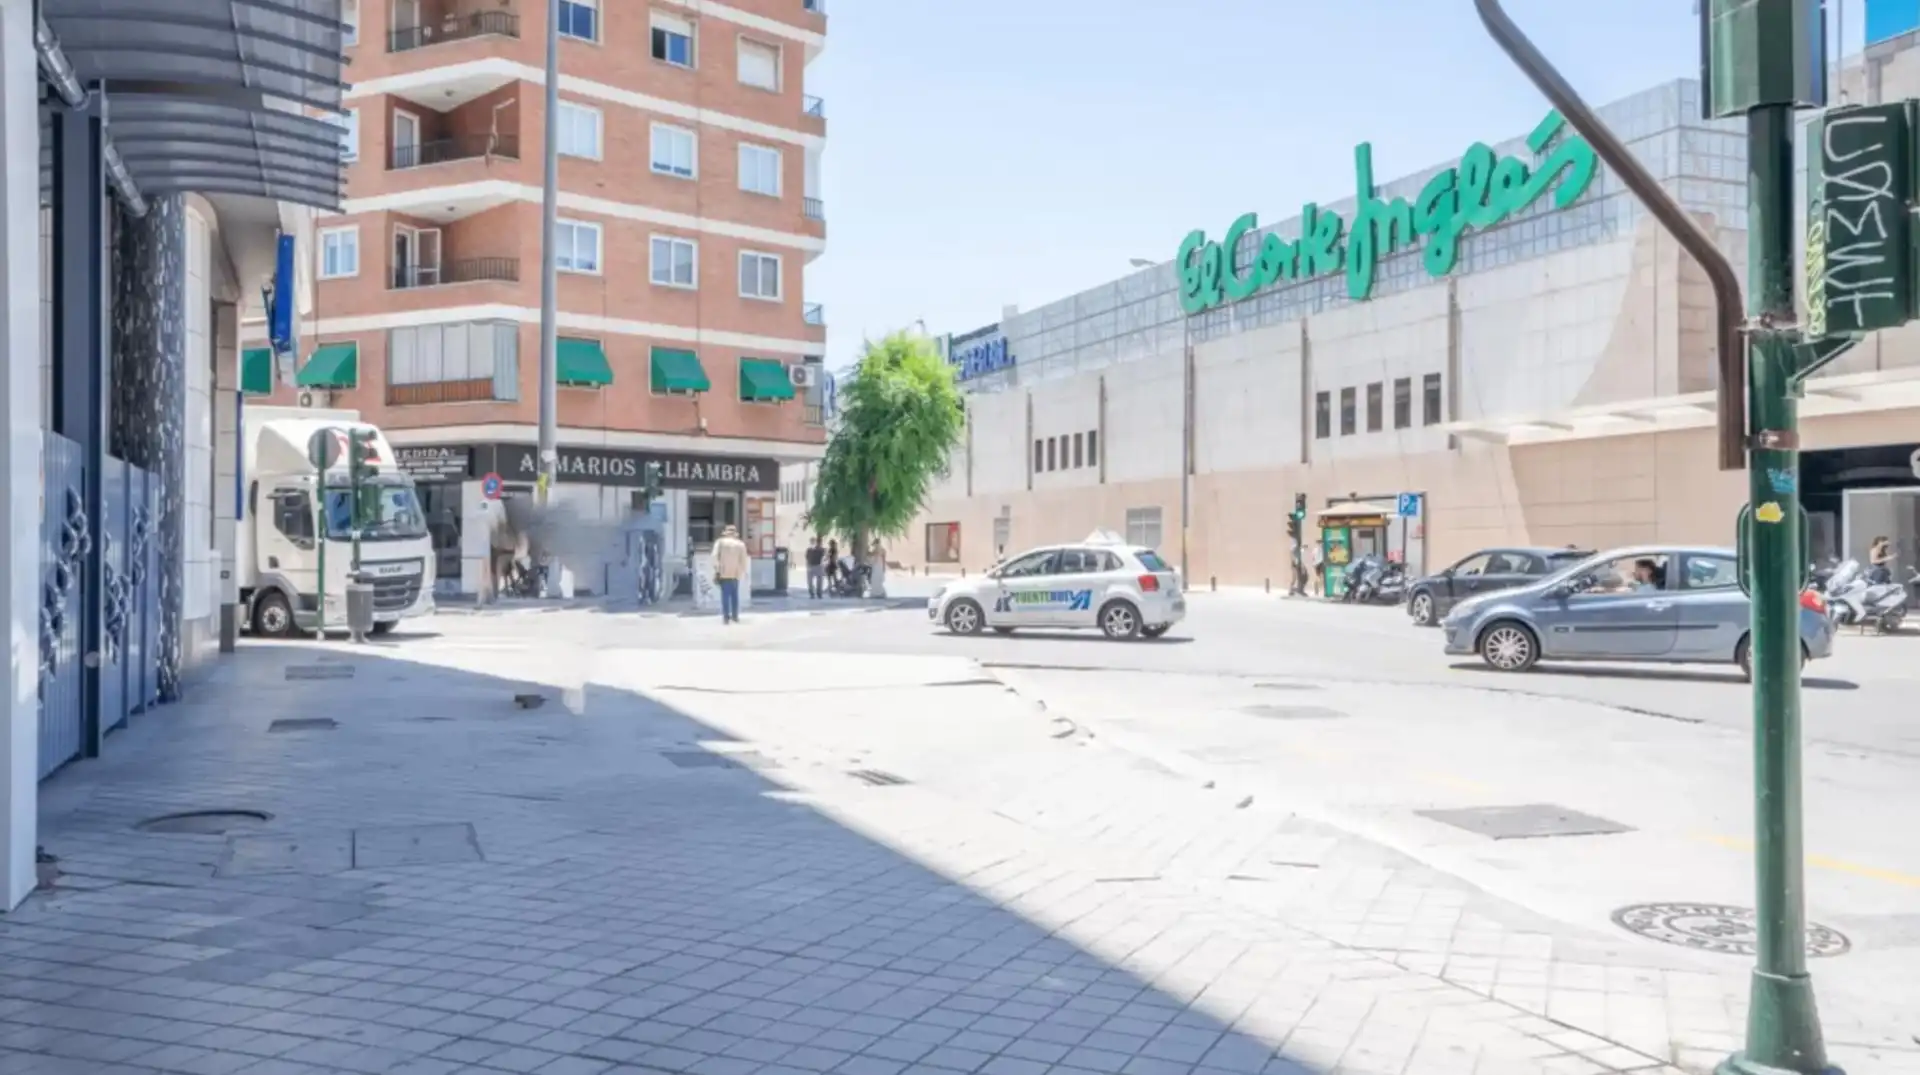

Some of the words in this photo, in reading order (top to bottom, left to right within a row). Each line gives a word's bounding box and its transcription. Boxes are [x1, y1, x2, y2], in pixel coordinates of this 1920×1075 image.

[1177, 229, 1224, 316] El
[1222, 203, 1345, 302] Corte
[1346, 107, 1598, 301] Inglés
[519, 452, 637, 477] AMARIOS
[655, 460, 761, 482] LHAMBRA
